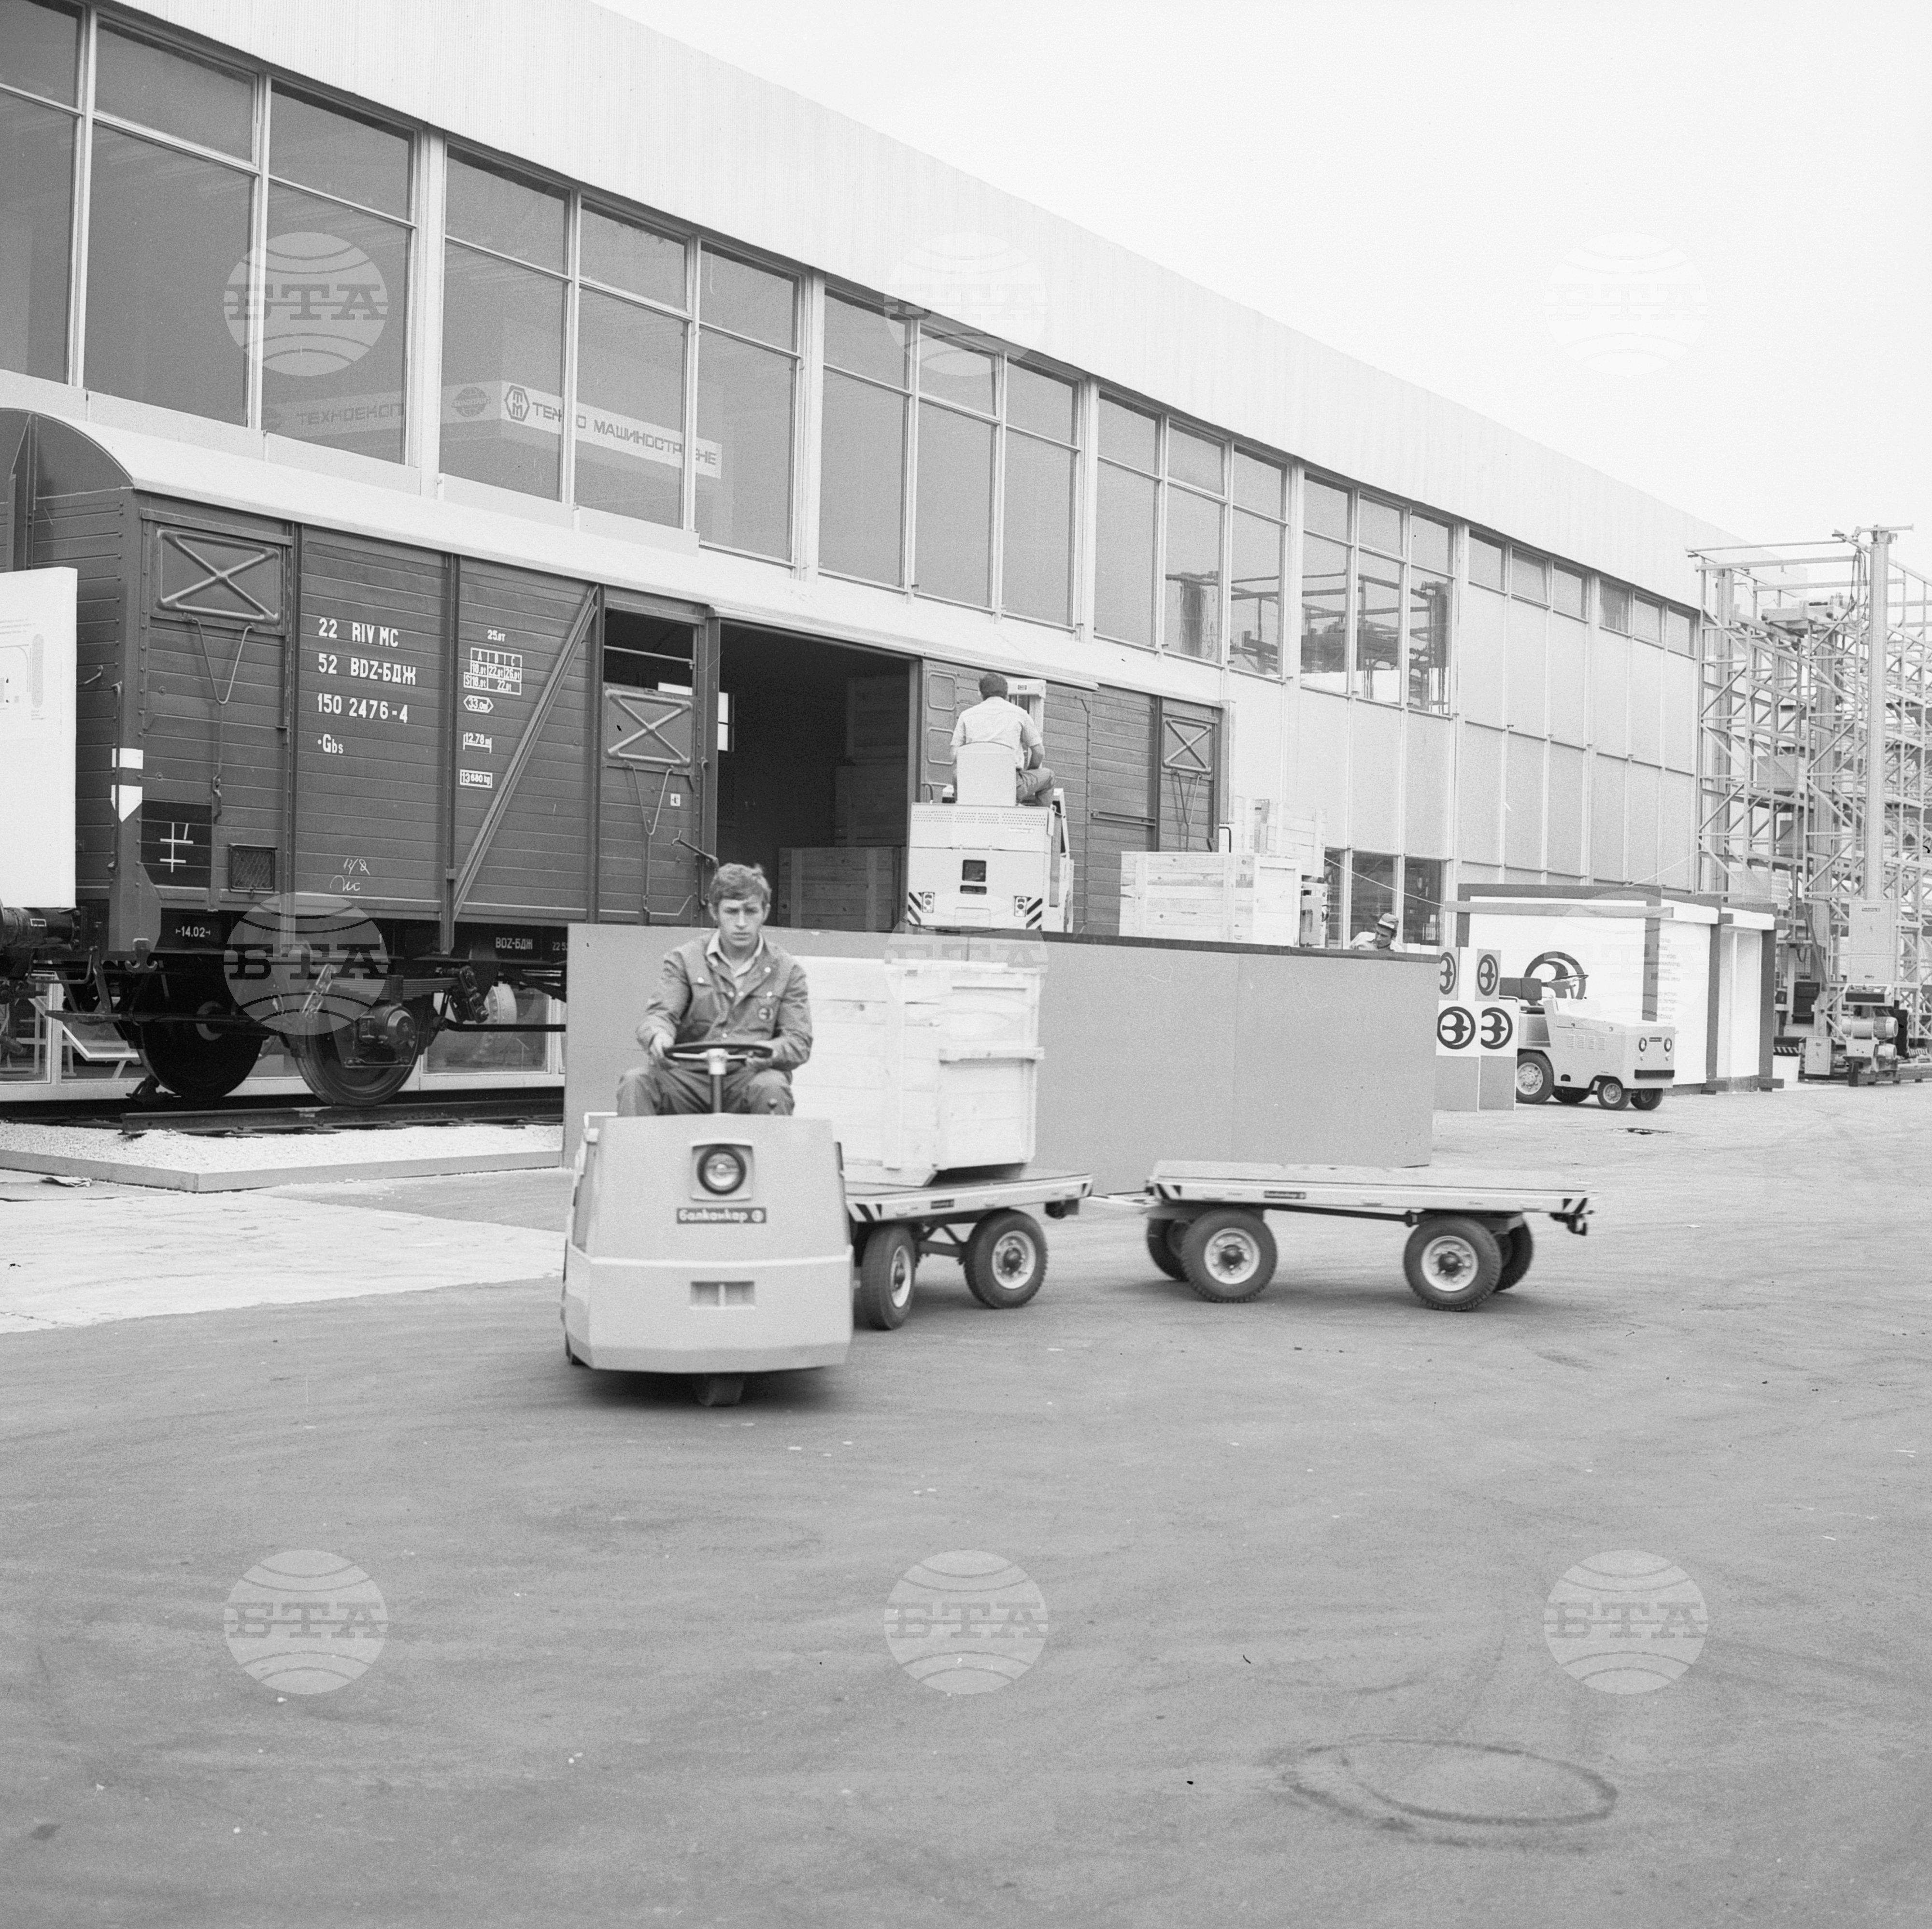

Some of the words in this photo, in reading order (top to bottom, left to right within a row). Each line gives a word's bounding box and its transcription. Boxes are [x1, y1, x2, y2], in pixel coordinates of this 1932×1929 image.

[318, 618, 338, 638] 22
[352, 622, 375, 644] RIV
[379, 627, 399, 647] MC
[318, 653, 337, 674] 52
[350, 657, 416, 685] BDZ-БДЖ
[317, 693, 342, 714] 150
[496, 937, 533, 950] BDZ-БДЖ
[561, 942, 568, 951] 5
